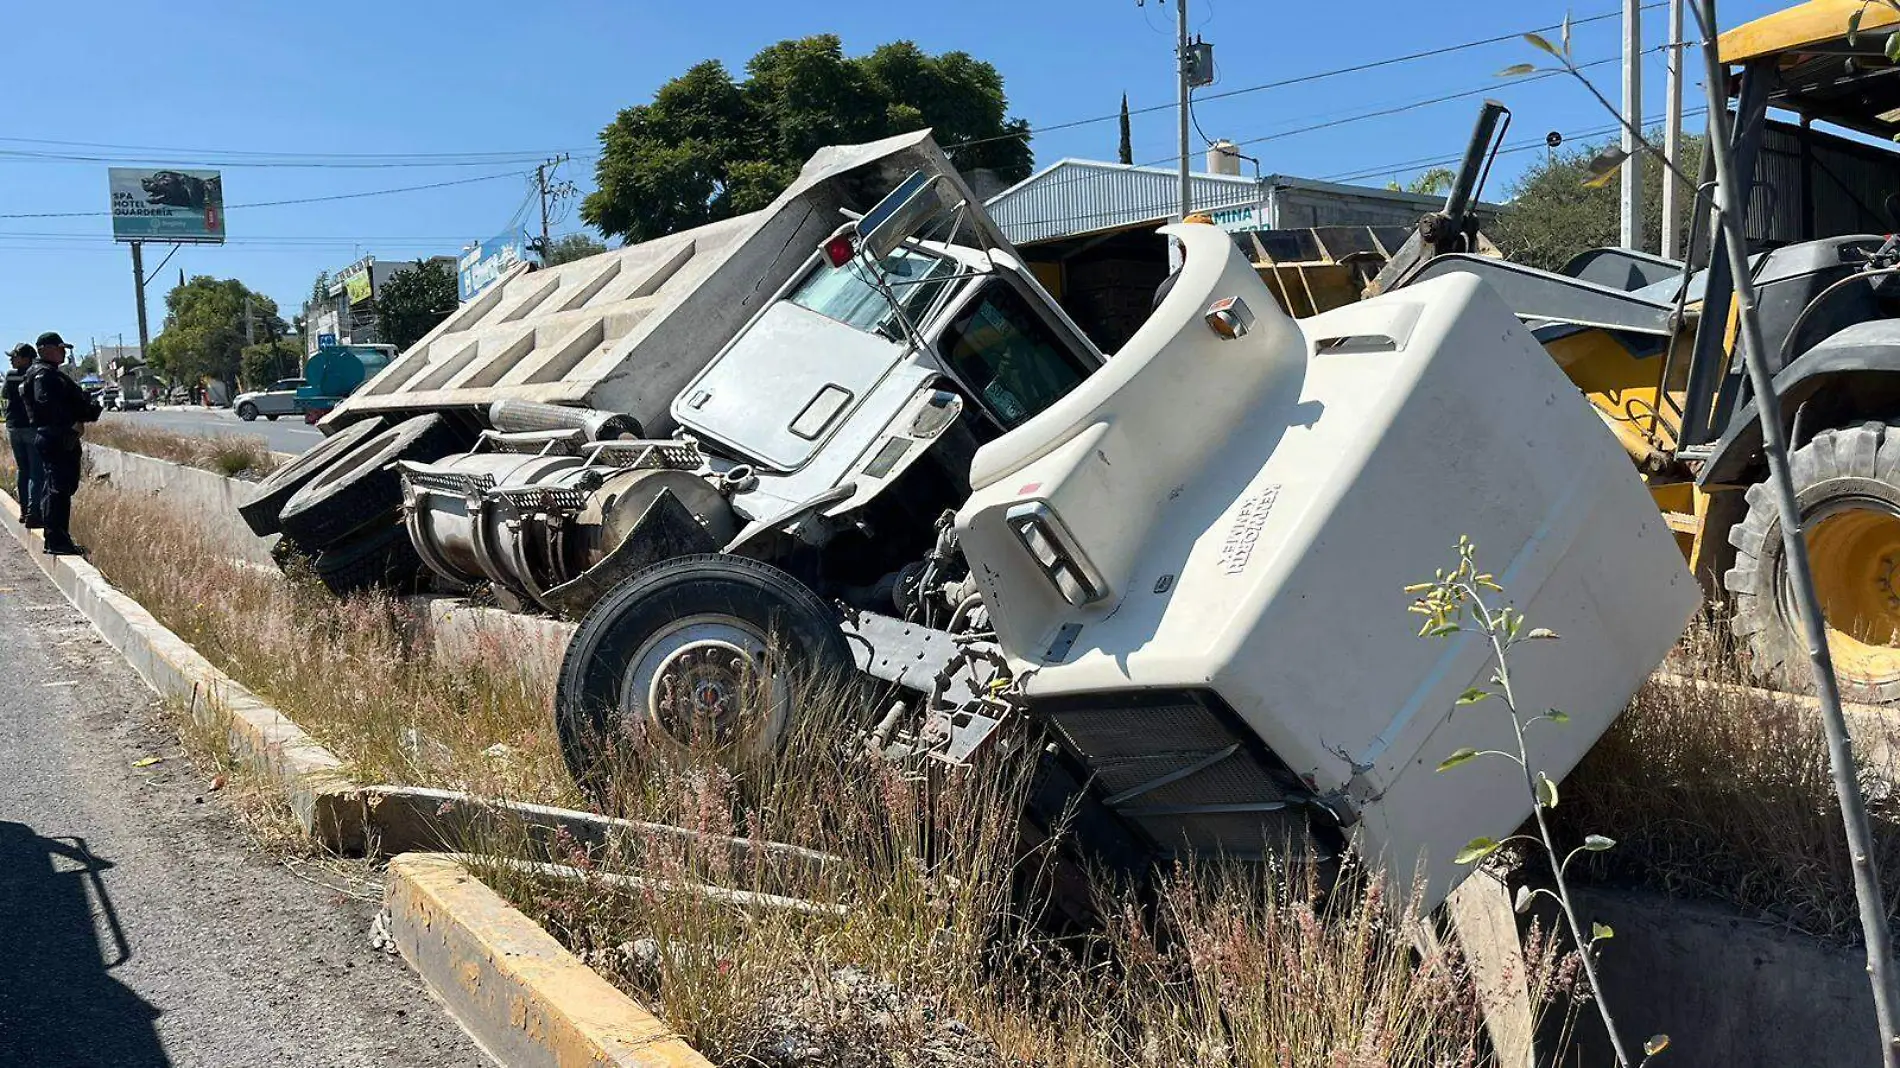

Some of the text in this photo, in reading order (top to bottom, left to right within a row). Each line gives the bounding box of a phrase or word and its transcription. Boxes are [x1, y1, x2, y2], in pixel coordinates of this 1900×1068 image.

[113, 192, 133, 200] SPA
[113, 200, 145, 208] HOTEL
[1216, 496, 1258, 566] KENMEX
[1224, 484, 1282, 576] KENWORTH
